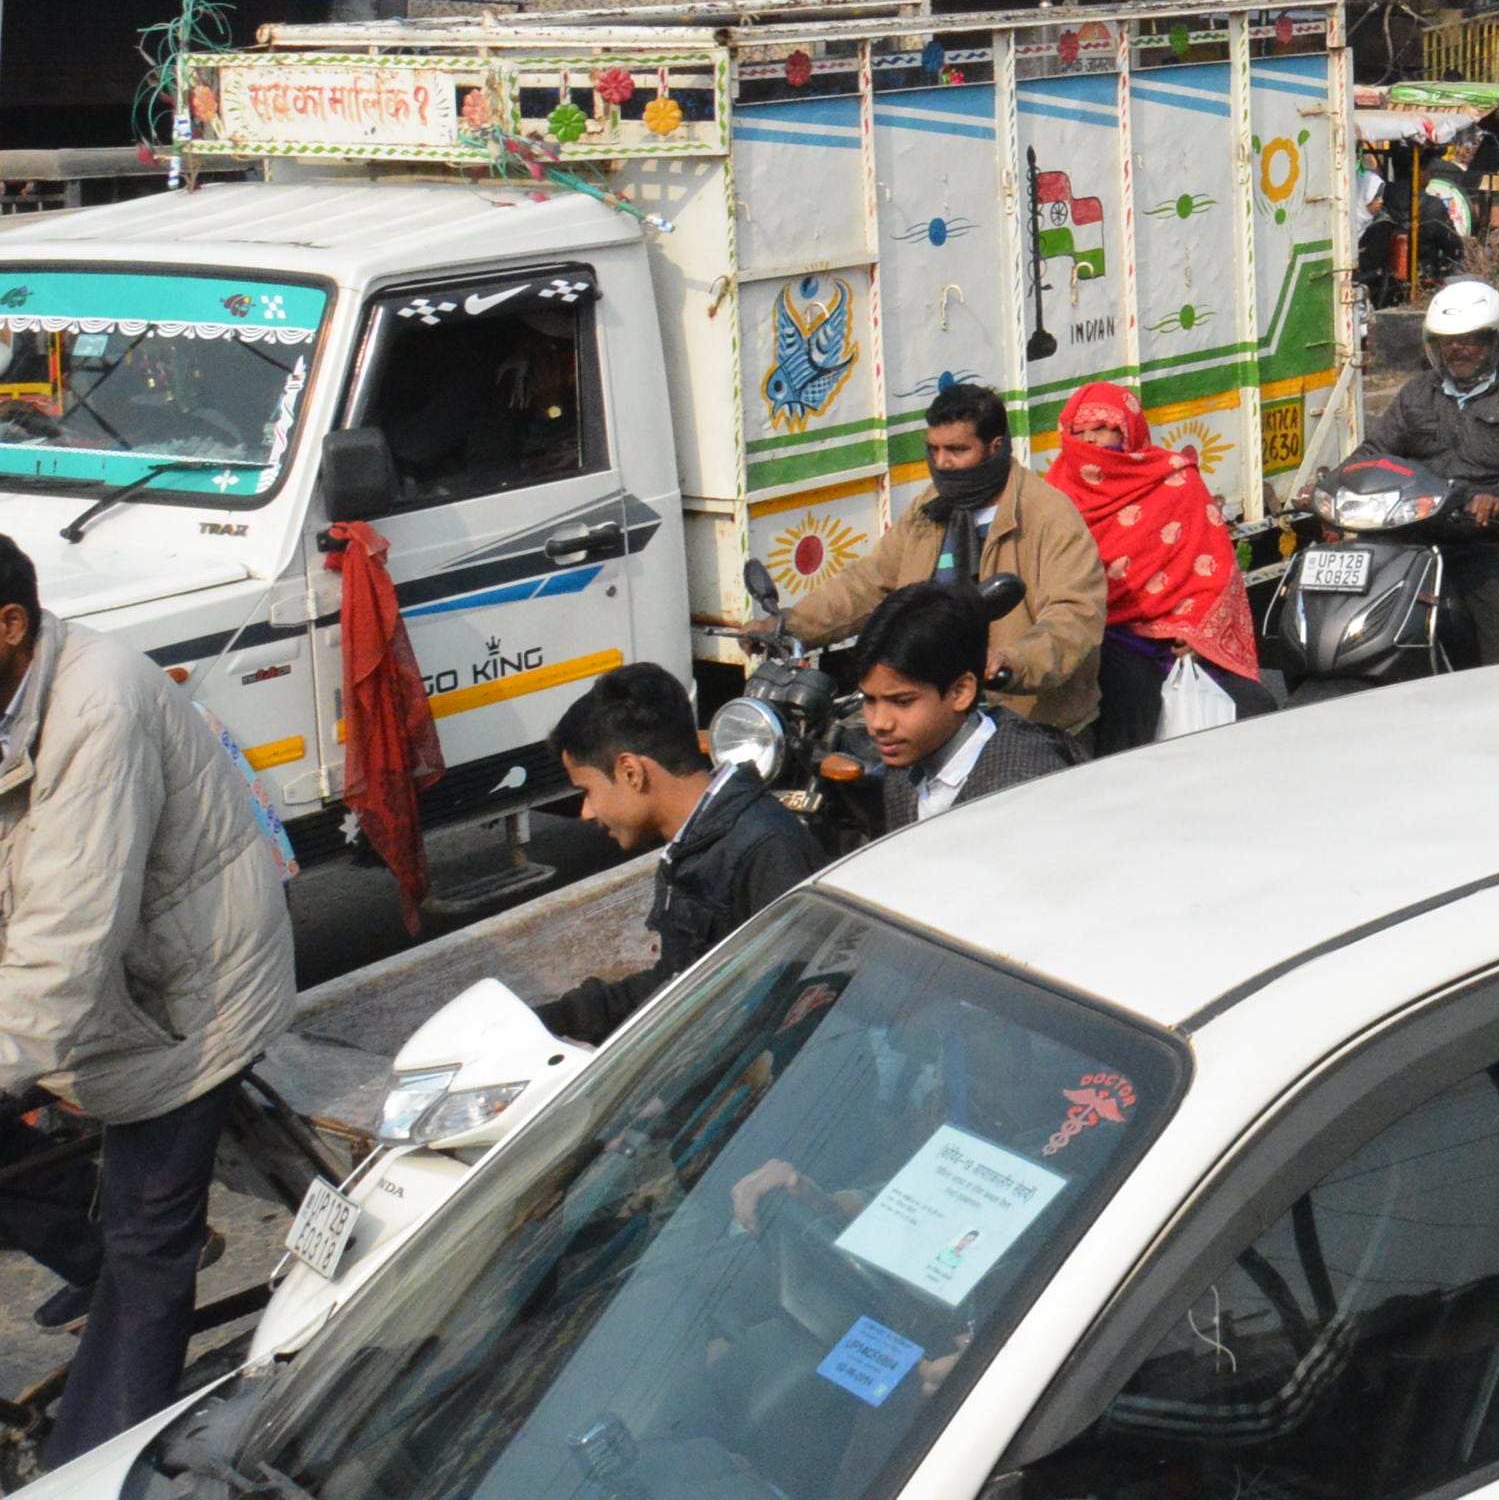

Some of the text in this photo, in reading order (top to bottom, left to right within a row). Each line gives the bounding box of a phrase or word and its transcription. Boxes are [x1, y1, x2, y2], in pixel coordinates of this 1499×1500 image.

[1070, 315, 1116, 346] INDIAN
[1263, 406, 1298, 433] K17CA
[1318, 553, 1365, 570] UP12B
[1314, 570, 1361, 585] K0825
[473, 647, 544, 684] KING
[1079, 1071, 1137, 1108] DOCTOR
[309, 1186, 351, 1237] UP12B
